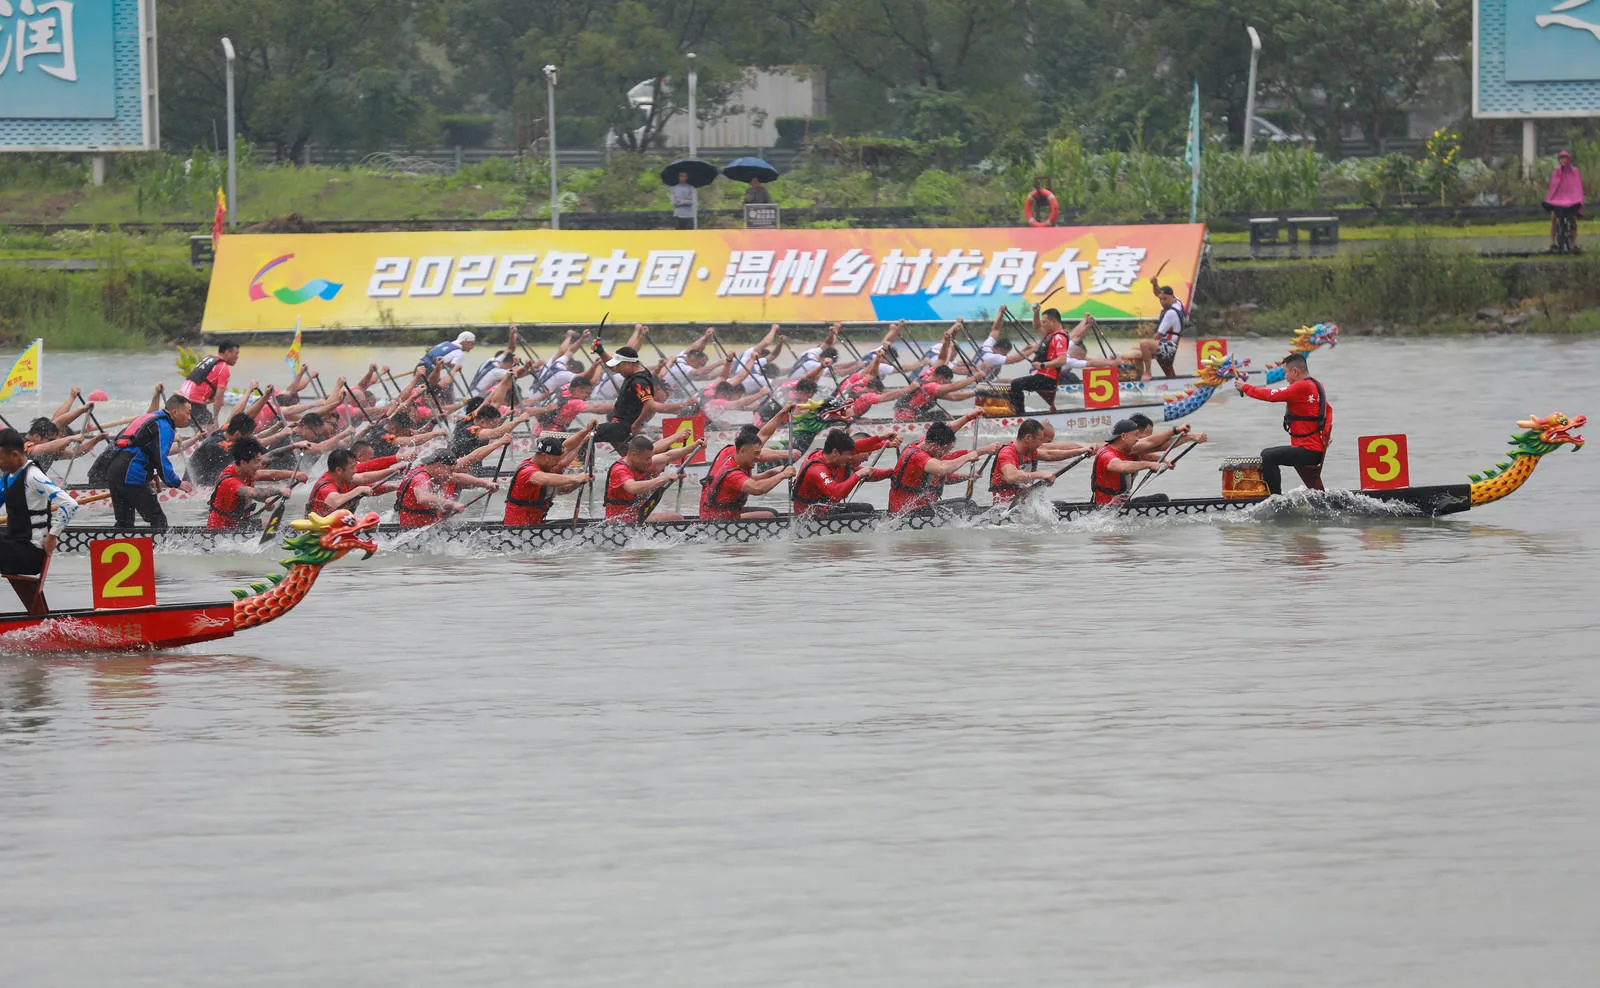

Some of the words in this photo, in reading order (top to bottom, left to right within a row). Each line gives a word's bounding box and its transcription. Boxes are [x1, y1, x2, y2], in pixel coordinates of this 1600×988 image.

[366, 246, 1147, 297] 2026年中国·温州乡村龙舟大赛
[1201, 341, 1224, 366] 6
[1089, 369, 1114, 402] 5
[670, 420, 697, 456] 4
[1366, 437, 1401, 482] 3
[101, 542, 144, 598] 2
